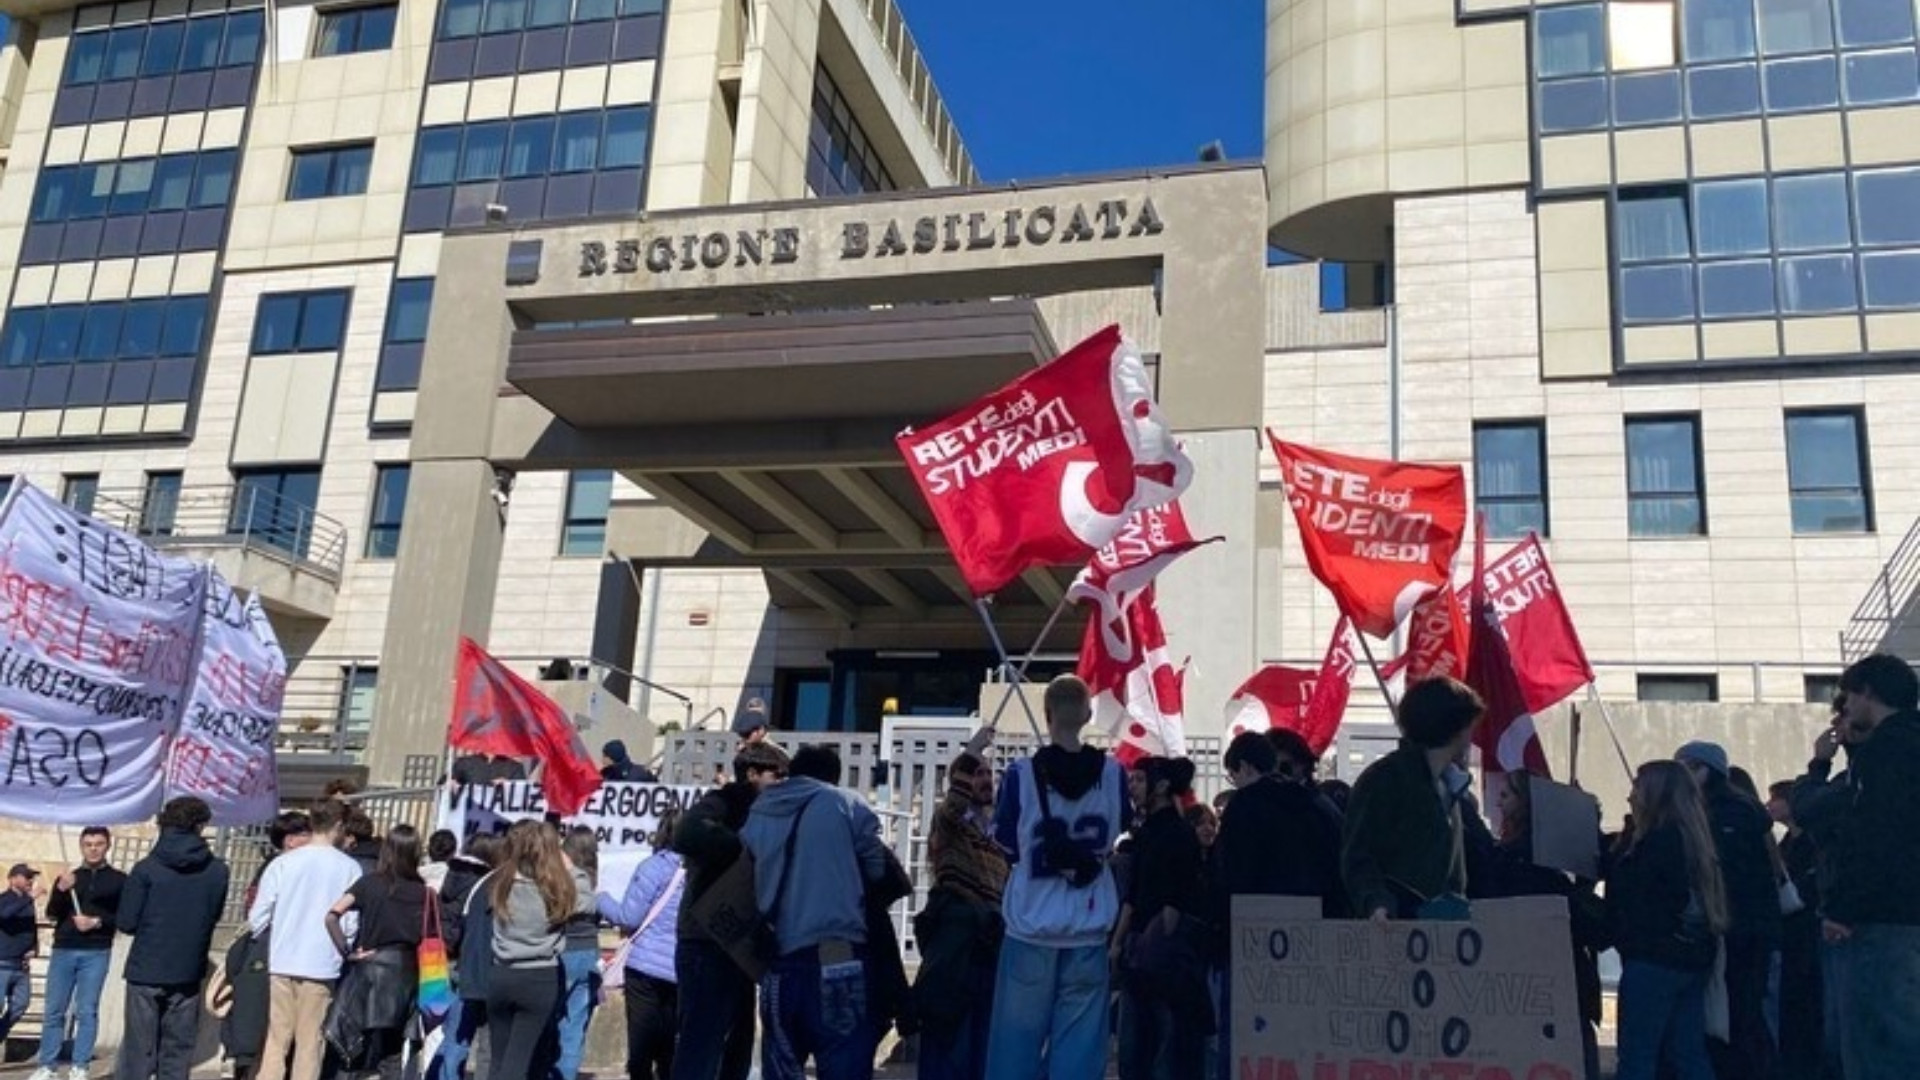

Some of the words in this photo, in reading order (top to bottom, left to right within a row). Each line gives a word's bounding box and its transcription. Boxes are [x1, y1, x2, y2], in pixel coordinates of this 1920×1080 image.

[579, 227, 799, 277] REGIONE
[840, 196, 1164, 260] BASILICATA
[912, 404, 999, 465] RETE
[925, 396, 1075, 495] STUDENTI
[1016, 426, 1087, 471] MEDI
[1286, 459, 1370, 502] ETE
[1352, 540, 1430, 565] MEDI
[1242, 926, 1320, 961] NON
[1388, 923, 1482, 966] SOLO
